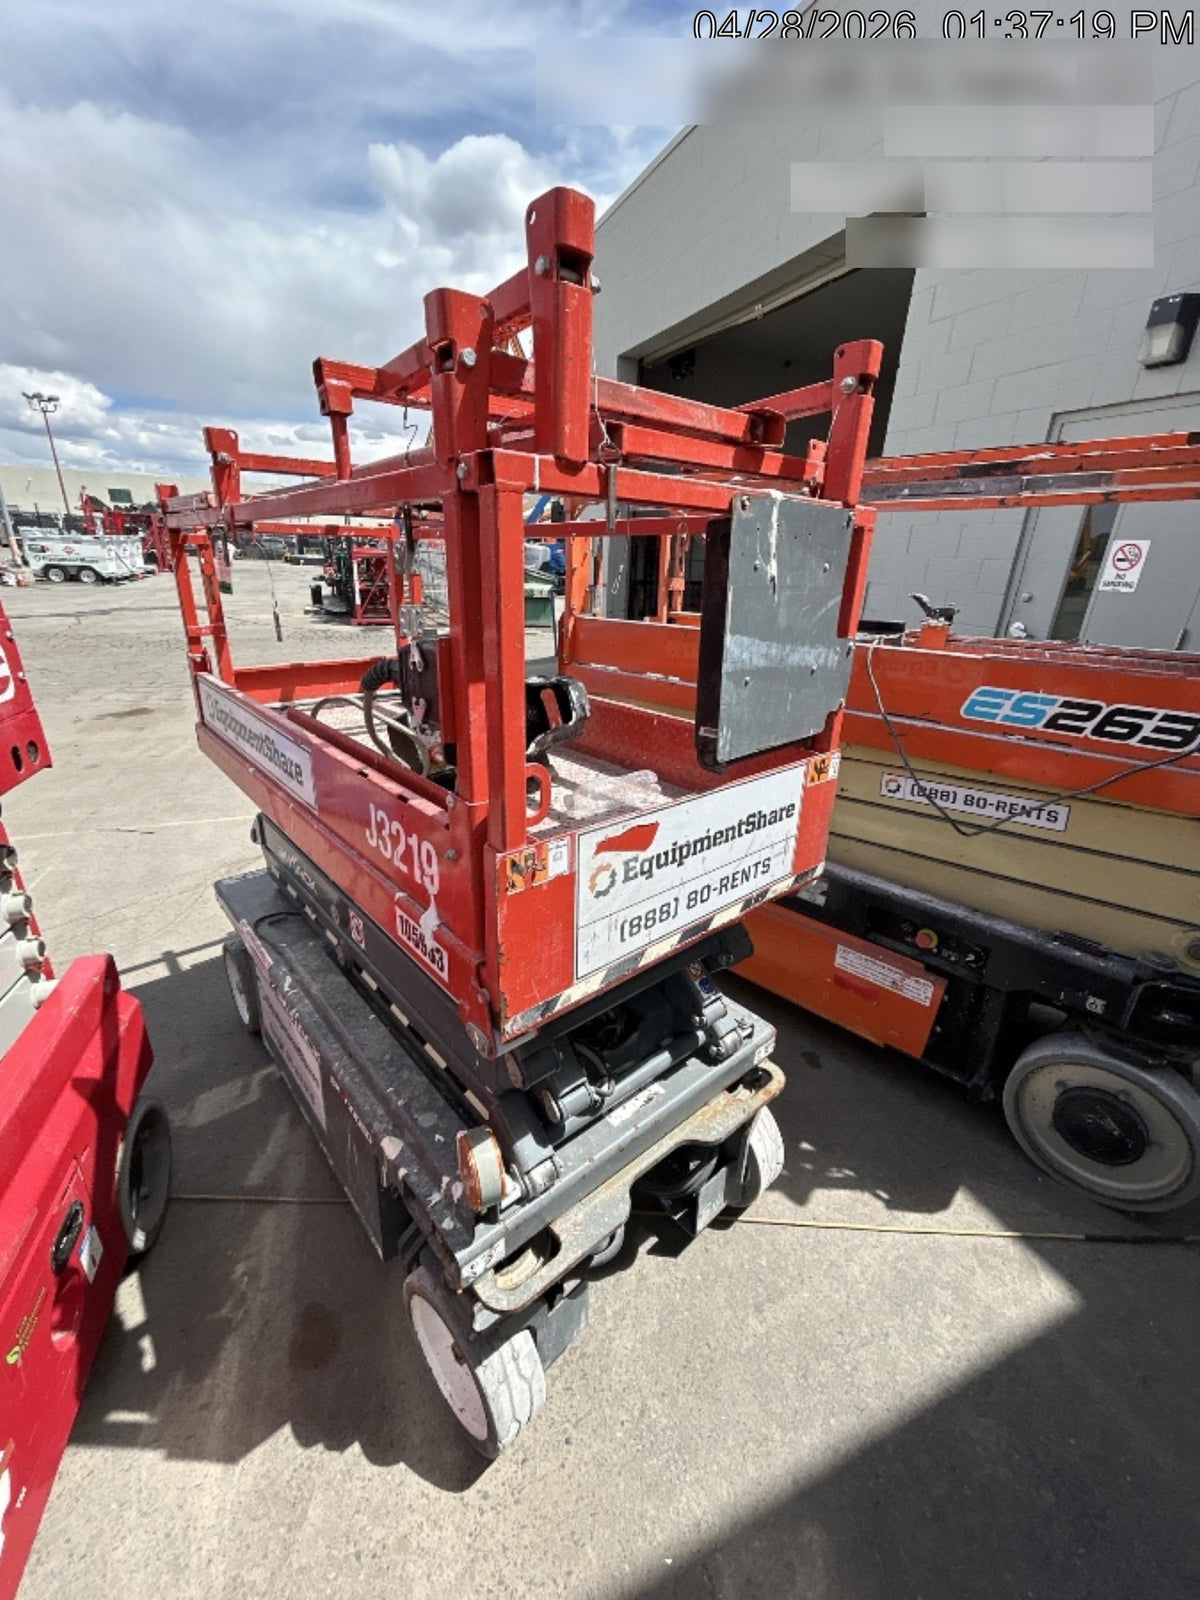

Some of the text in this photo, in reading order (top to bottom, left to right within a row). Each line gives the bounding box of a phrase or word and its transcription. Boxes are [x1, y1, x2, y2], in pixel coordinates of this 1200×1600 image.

[963, 689, 1200, 751] ES263
[622, 803, 796, 883] EquipmentShare
[911, 783, 1059, 824] (888) 80-RENTS
[365, 802, 440, 895] J3219
[620, 857, 771, 942] (888) 80-RENTS
